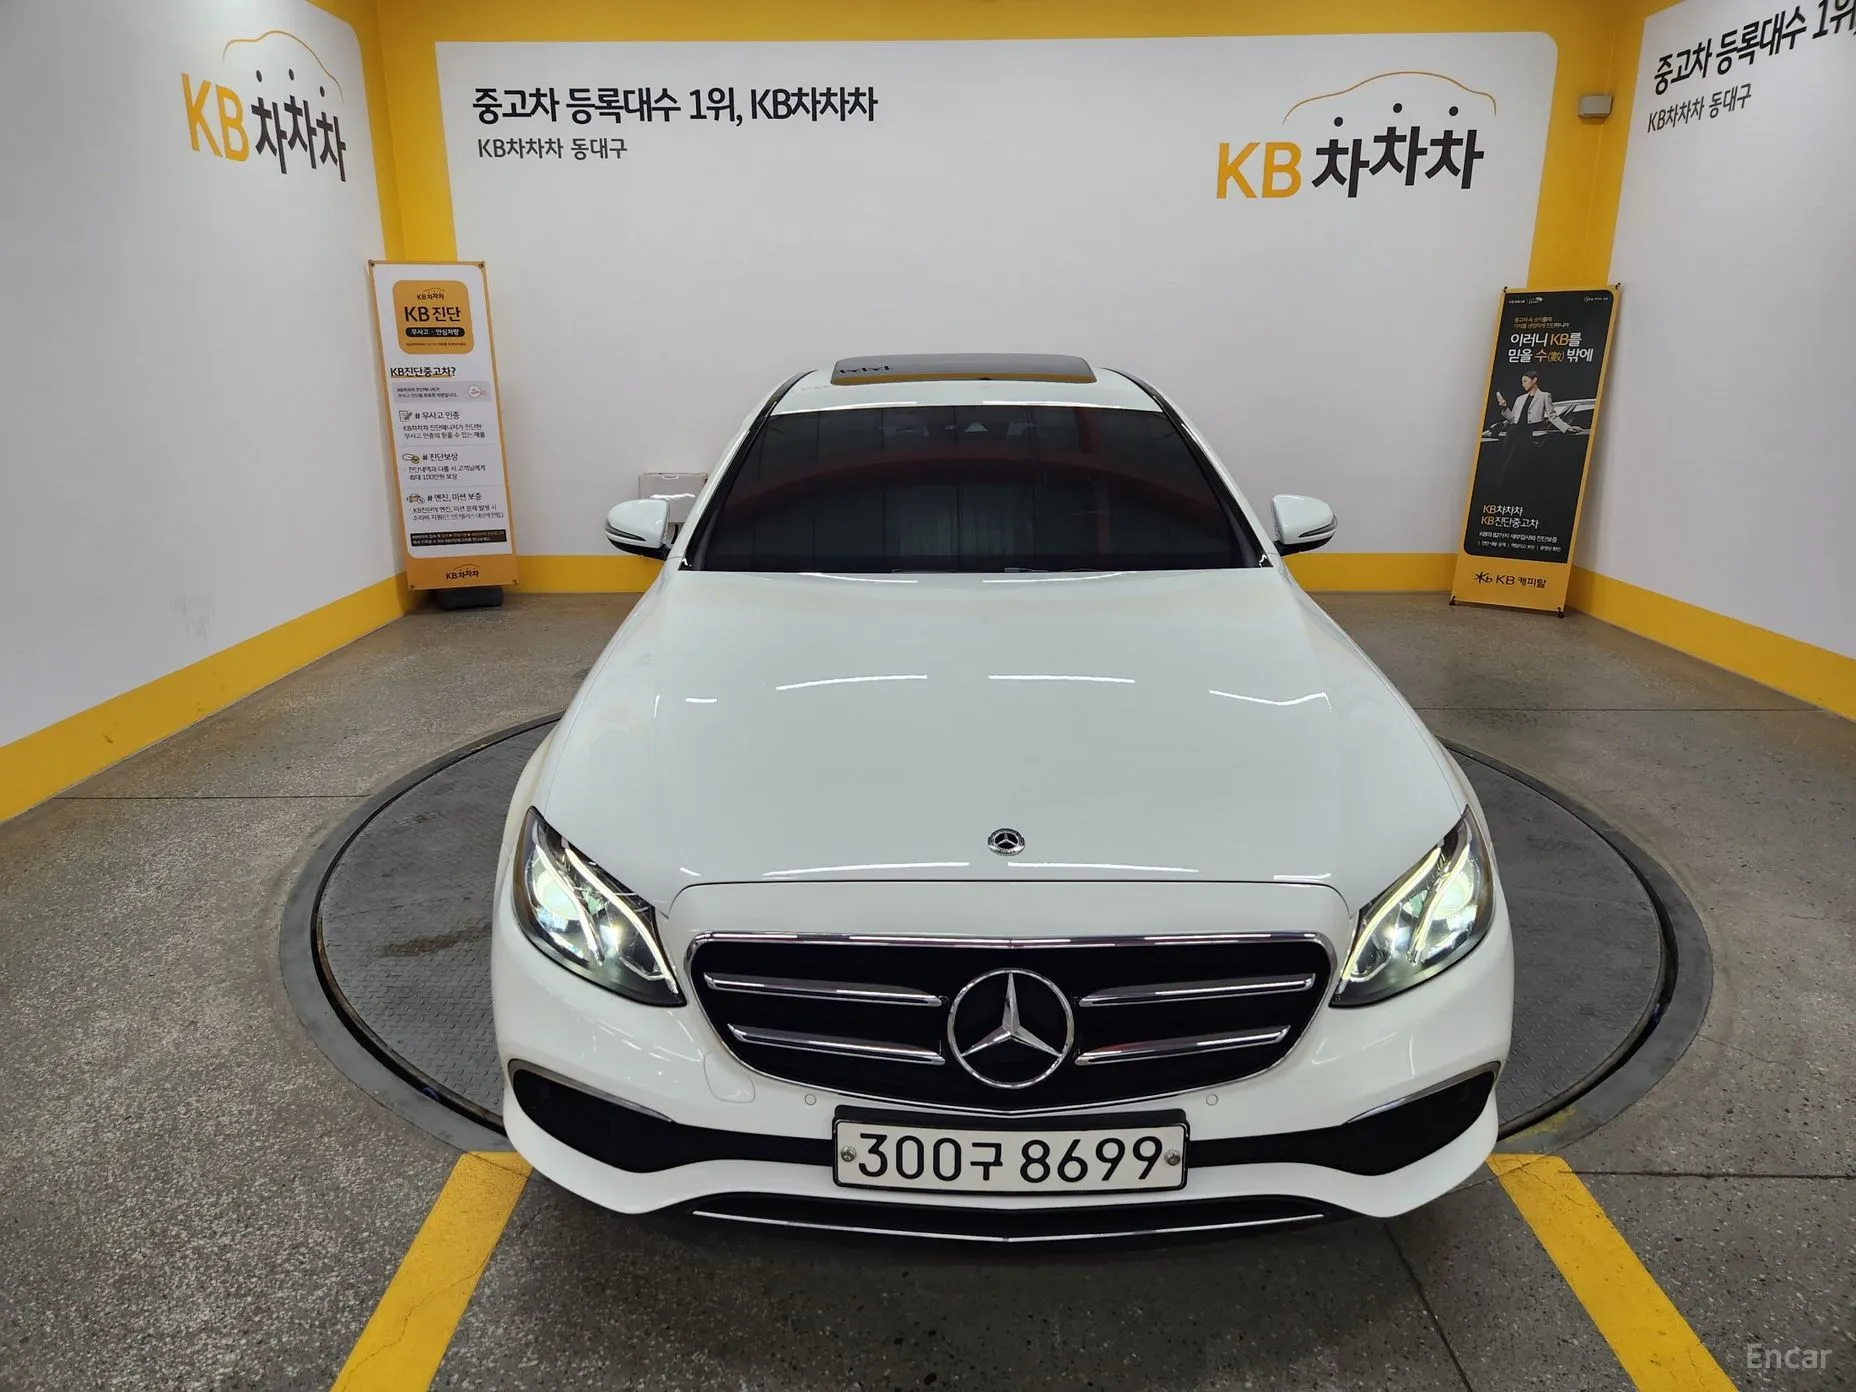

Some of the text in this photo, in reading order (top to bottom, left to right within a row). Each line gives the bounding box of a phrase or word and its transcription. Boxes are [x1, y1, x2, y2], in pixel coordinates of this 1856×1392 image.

[1654, 38, 1712, 96] 중고차
[1716, 6, 1807, 75] 등록대수
[472, 86, 878, 127] 중고차 등록대수 1위, KB차차차
[1647, 83, 1751, 133] KB차차차 동대구
[477, 138, 628, 160] KB차차차 동대구
[404, 306, 461, 322] KB 진단
[411, 328, 429, 336] 무사고
[1510, 332, 1582, 347] 이러니 KB를
[1508, 348, 1533, 363] 믿을
[1567, 348, 1594, 363] 밖에
[390, 366, 456, 378] KB진단중고차?
[422, 411, 444, 420] 무사고
[445, 411, 460, 420] 인증
[429, 453, 458, 462] 진단보상
[452, 493, 466, 501] 미션
[467, 493, 482, 501] 보증
[1483, 504, 1524, 516] KB차차차
[1481, 516, 1539, 529] KB진단중고차
[1496, 574, 1515, 586] KB
[1518, 576, 1547, 589] 캐피탈
[858, 1133, 1163, 1184] 300구 8699
